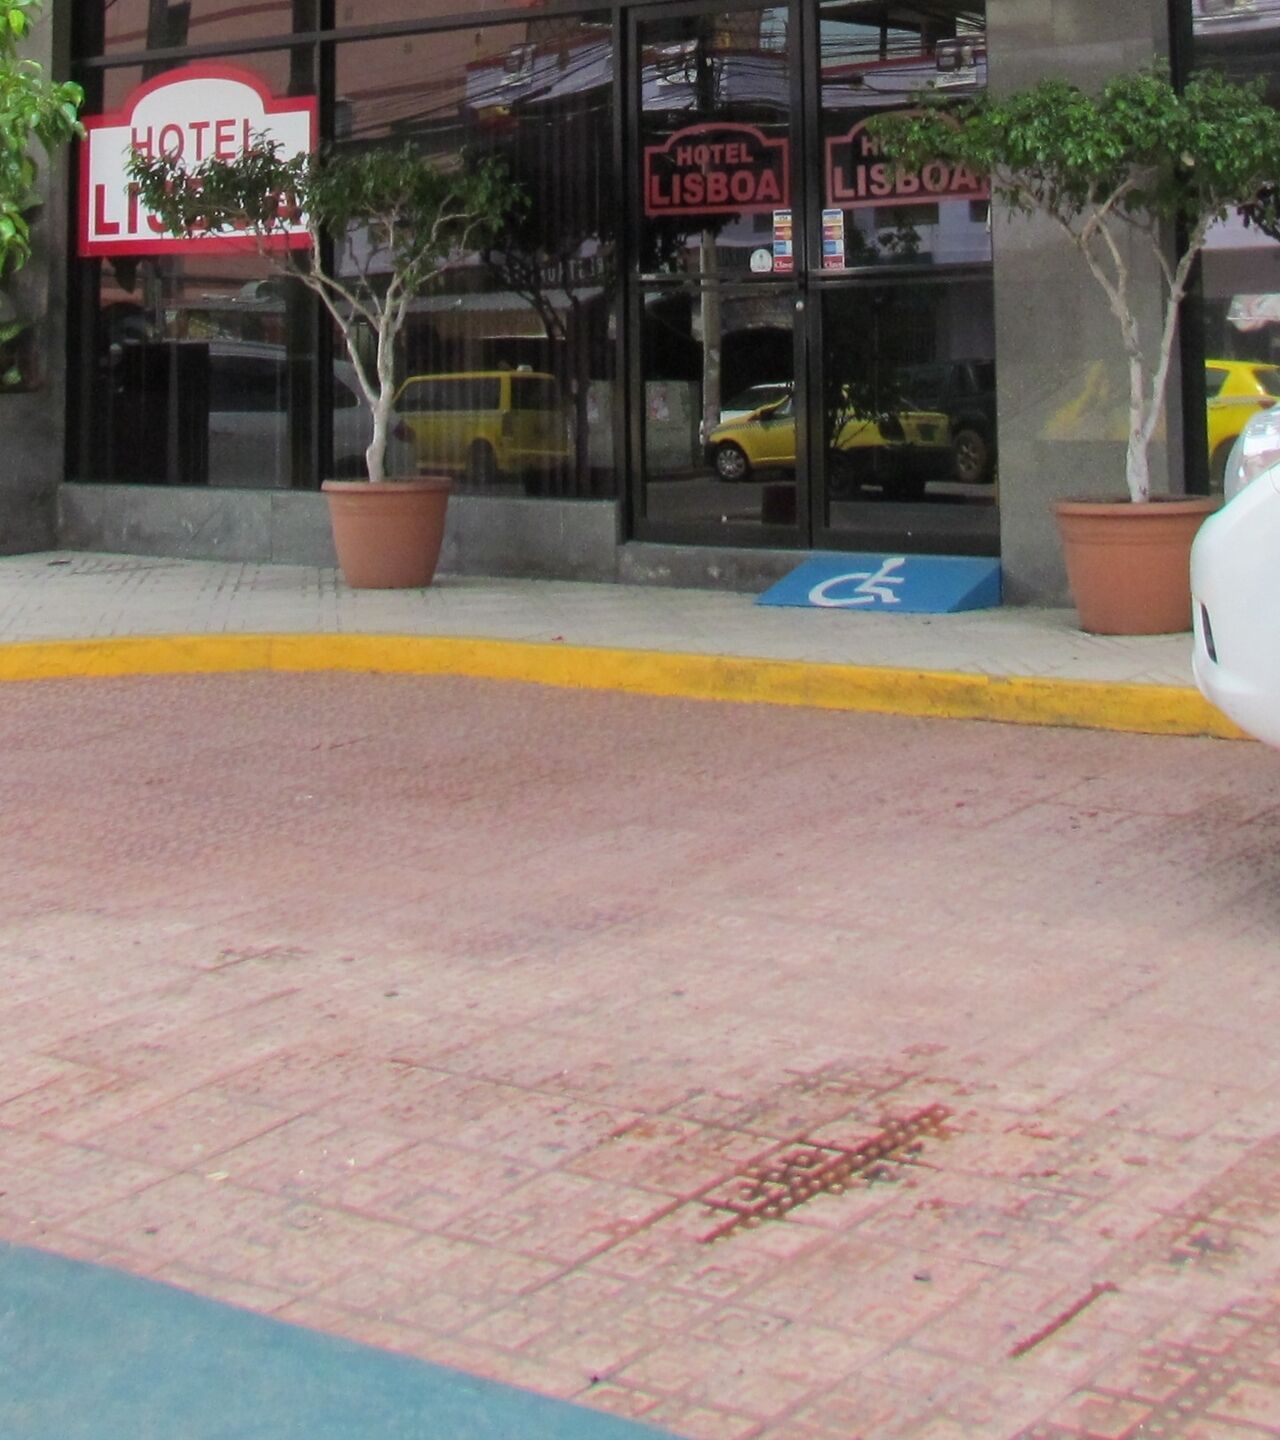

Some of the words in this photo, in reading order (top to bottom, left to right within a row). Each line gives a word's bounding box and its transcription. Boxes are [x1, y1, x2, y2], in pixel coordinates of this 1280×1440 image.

[131, 118, 261, 165] HOTEL
[677, 143, 754, 166] HOTEL
[651, 169, 782, 205] LISBOA
[833, 160, 978, 198] LISBOA
